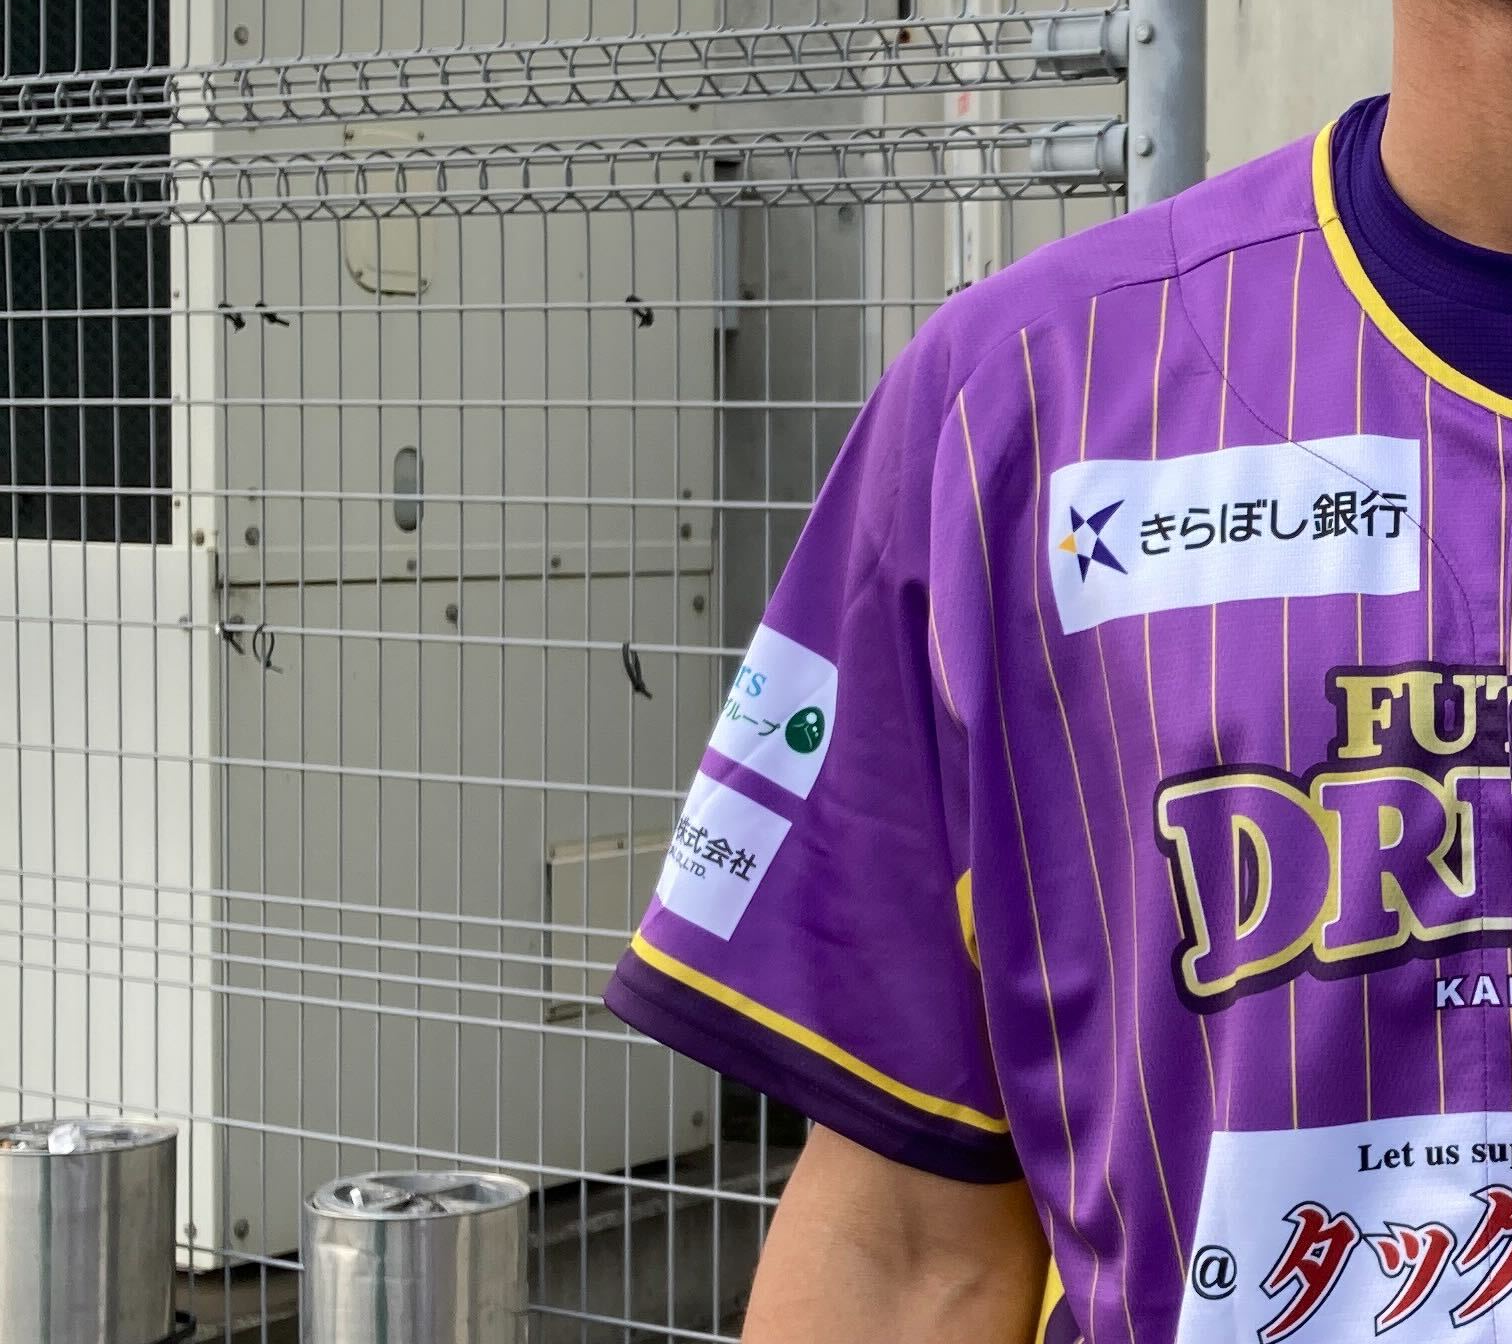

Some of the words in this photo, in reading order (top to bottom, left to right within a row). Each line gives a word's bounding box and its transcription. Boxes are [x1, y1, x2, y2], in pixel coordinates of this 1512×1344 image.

[1139, 490, 1408, 556] きらぼし銀行
[1357, 1141, 1415, 1172] Let
[1425, 1143, 1460, 1166] us
